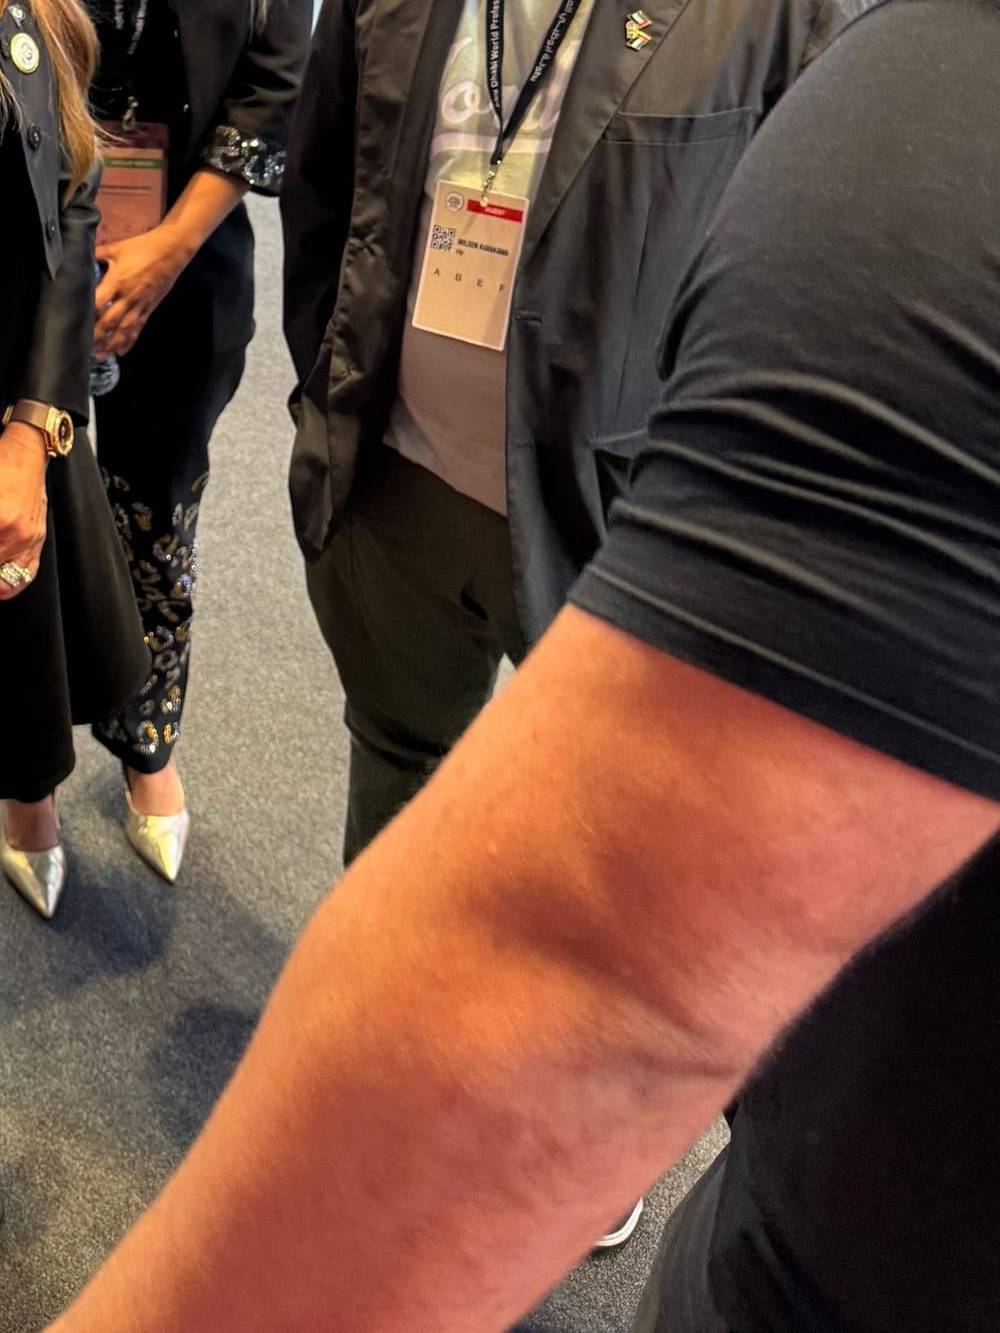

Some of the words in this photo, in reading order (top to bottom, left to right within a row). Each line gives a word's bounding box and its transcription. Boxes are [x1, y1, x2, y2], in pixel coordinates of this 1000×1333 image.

[490, 31, 500, 60] World
[489, 60, 498, 88] Dhabi
[433, 267, 441, 276] A
[476, 278, 483, 287] E
